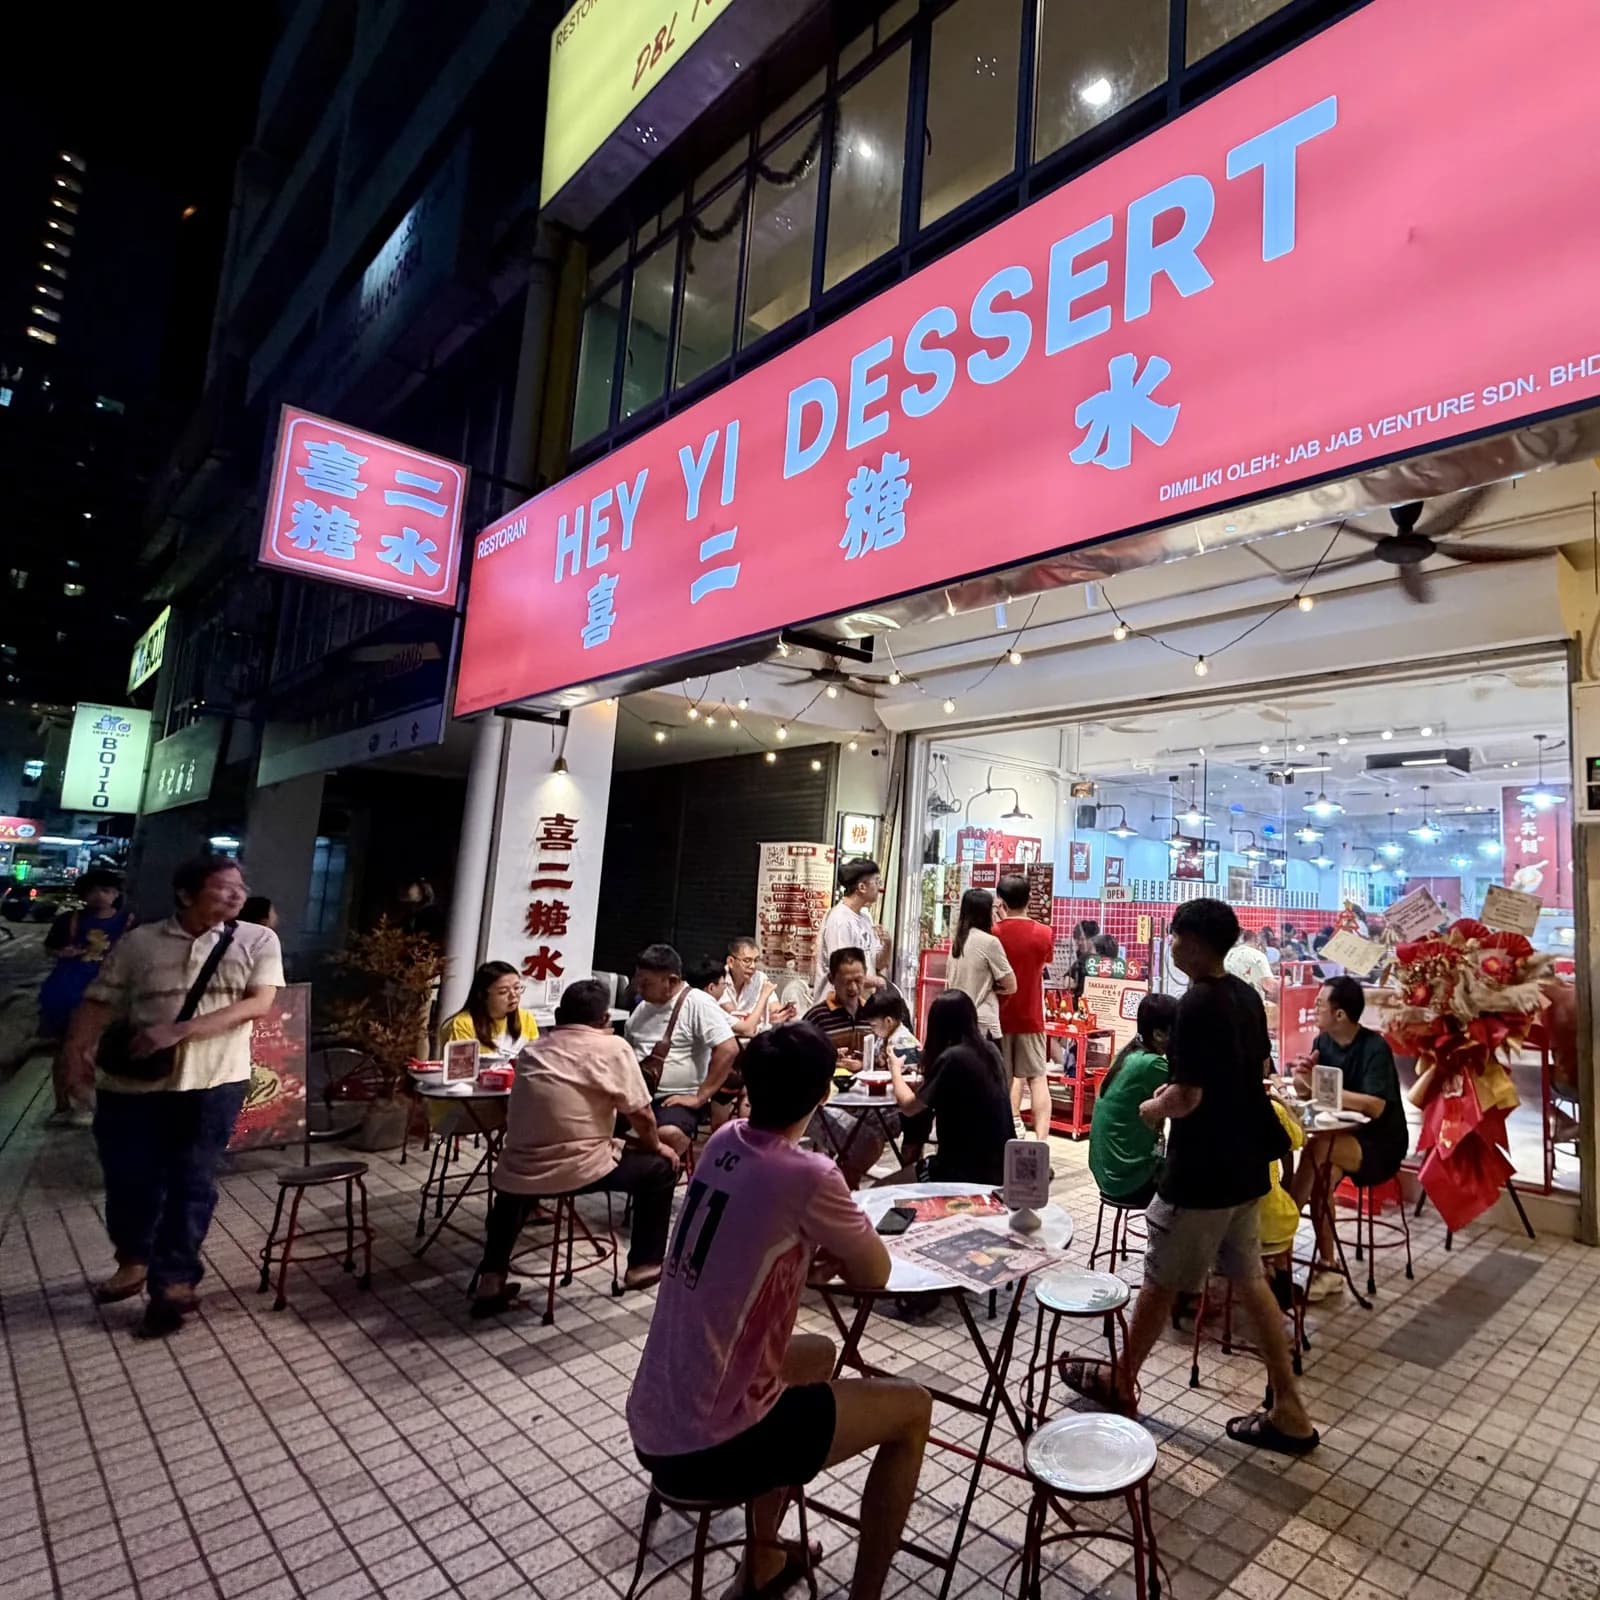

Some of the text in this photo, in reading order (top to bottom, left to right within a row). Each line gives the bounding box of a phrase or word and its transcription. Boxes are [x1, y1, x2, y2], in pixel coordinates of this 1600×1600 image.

[554, 95, 1338, 583] HEY YI DESSERT
[1159, 353, 1600, 502] DIMILIKI OLEH: JAB JAB VENTURE SDN. BHD
[297, 440, 447, 518] 喜二
[286, 500, 442, 577] 糖水
[477, 516, 528, 560] RESTORAN
[92, 737, 118, 808] BOJIO
[521, 813, 580, 981] 喜二糖水
[1106, 890, 1125, 900] OPEN
[1088, 981, 1118, 990] TAKEAWAY
[714, 1151, 741, 1173] JC
